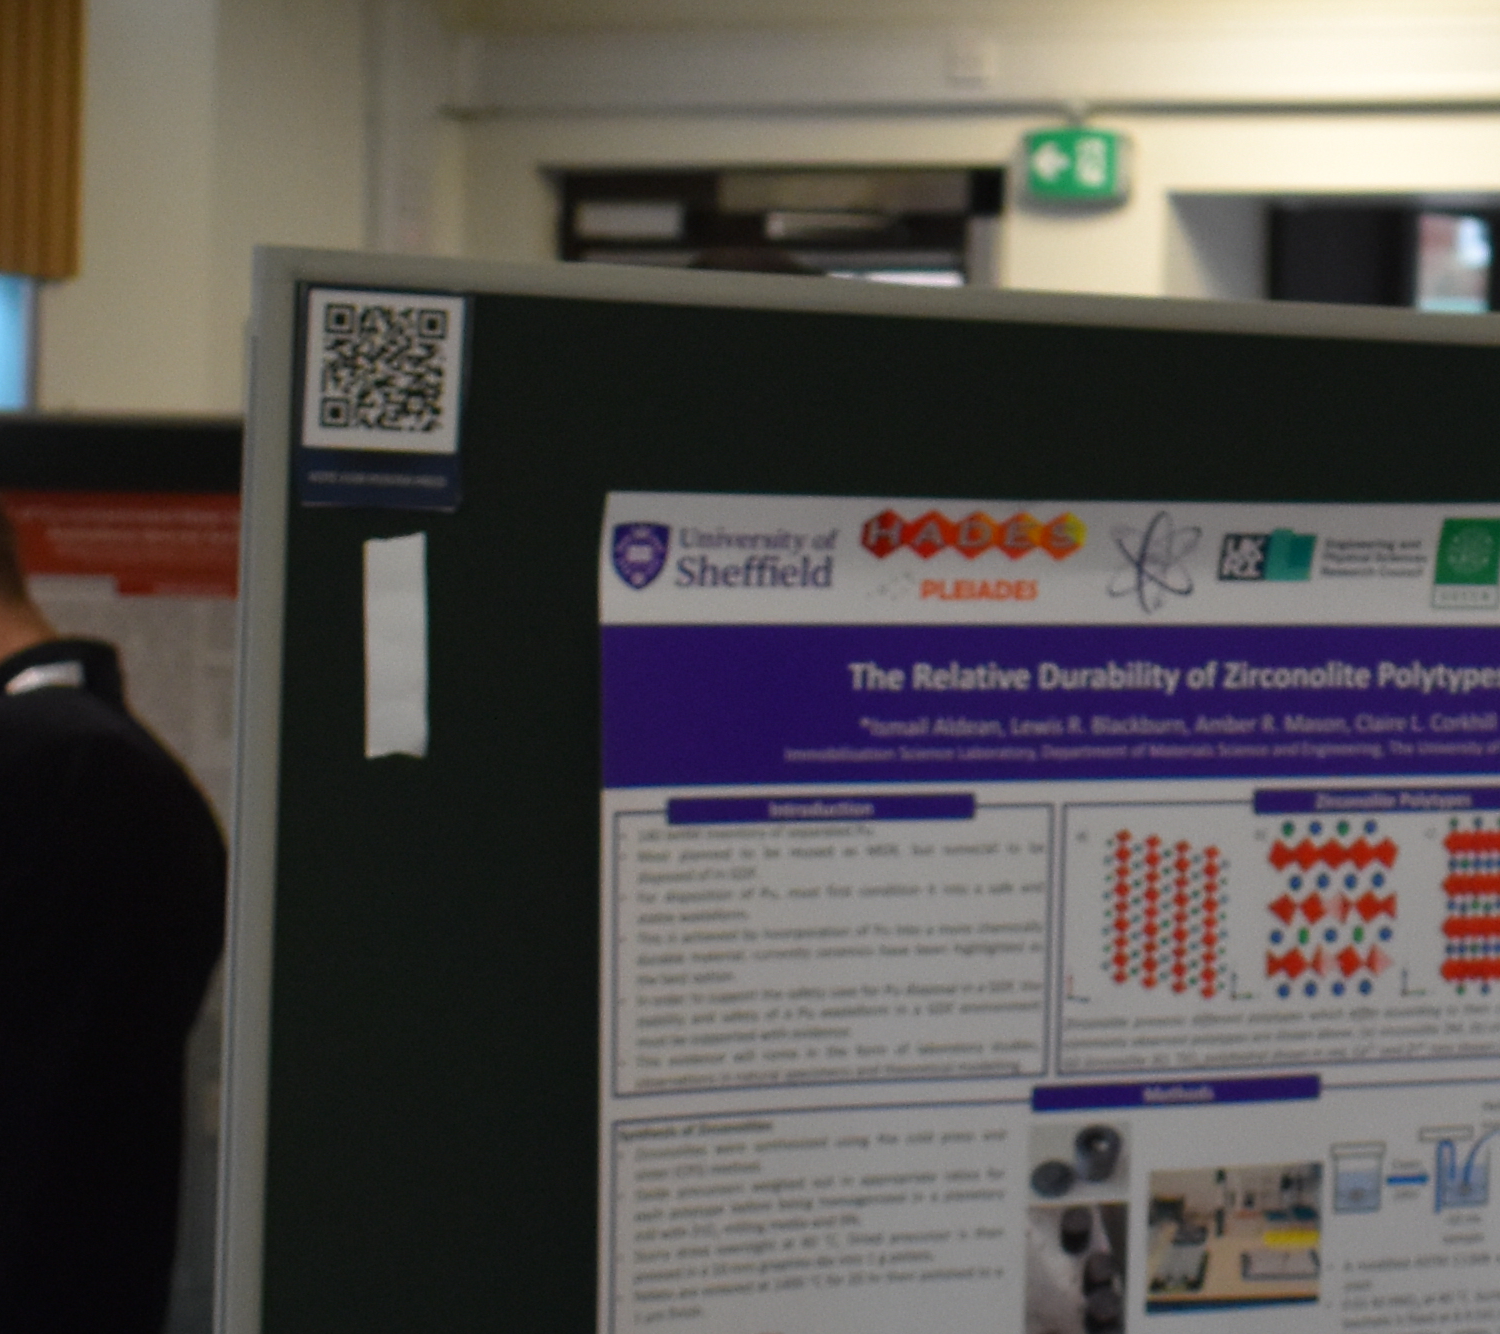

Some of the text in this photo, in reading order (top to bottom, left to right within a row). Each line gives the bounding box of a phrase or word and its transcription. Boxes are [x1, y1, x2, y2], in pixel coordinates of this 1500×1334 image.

[679, 527, 839, 551] University of
[869, 519, 1078, 548] HADES
[1324, 538, 1422, 552] Engineering and
[673, 555, 833, 588] Sheffield
[919, 578, 1039, 601] PLEIADES
[848, 663, 906, 690] The
[913, 662, 1031, 690] Relative
[1038, 662, 1180, 696] Durability
[1186, 662, 1219, 690] of
[1222, 662, 1371, 690] Zirconolite
[1011, 716, 1065, 735] Lewis
[1068, 716, 1087, 735] R.
[1091, 715, 1190, 737] Blackburn,
[1194, 715, 1257, 734] Amber
[1260, 714, 1280, 733] R.
[1284, 714, 1352, 736] Mason,
[1355, 713, 1406, 733] Claire
[1410, 713, 1426, 732] L.
[1430, 713, 1498, 732] Corkhill
[899, 745, 953, 761] Science
[1041, 744, 1125, 761] Department
[1149, 743, 1215, 759] Materials
[1218, 743, 1268, 758] Science
[1272, 742, 1298, 757] and
[1301, 741, 1383, 759] Engineering,
[1388, 741, 1413, 756] The
[1417, 741, 1484, 758] University
[768, 799, 874, 818] Introduction
[1315, 790, 1472, 812] Zirconolite Polytypes
[1143, 1083, 1216, 1105] Methods
